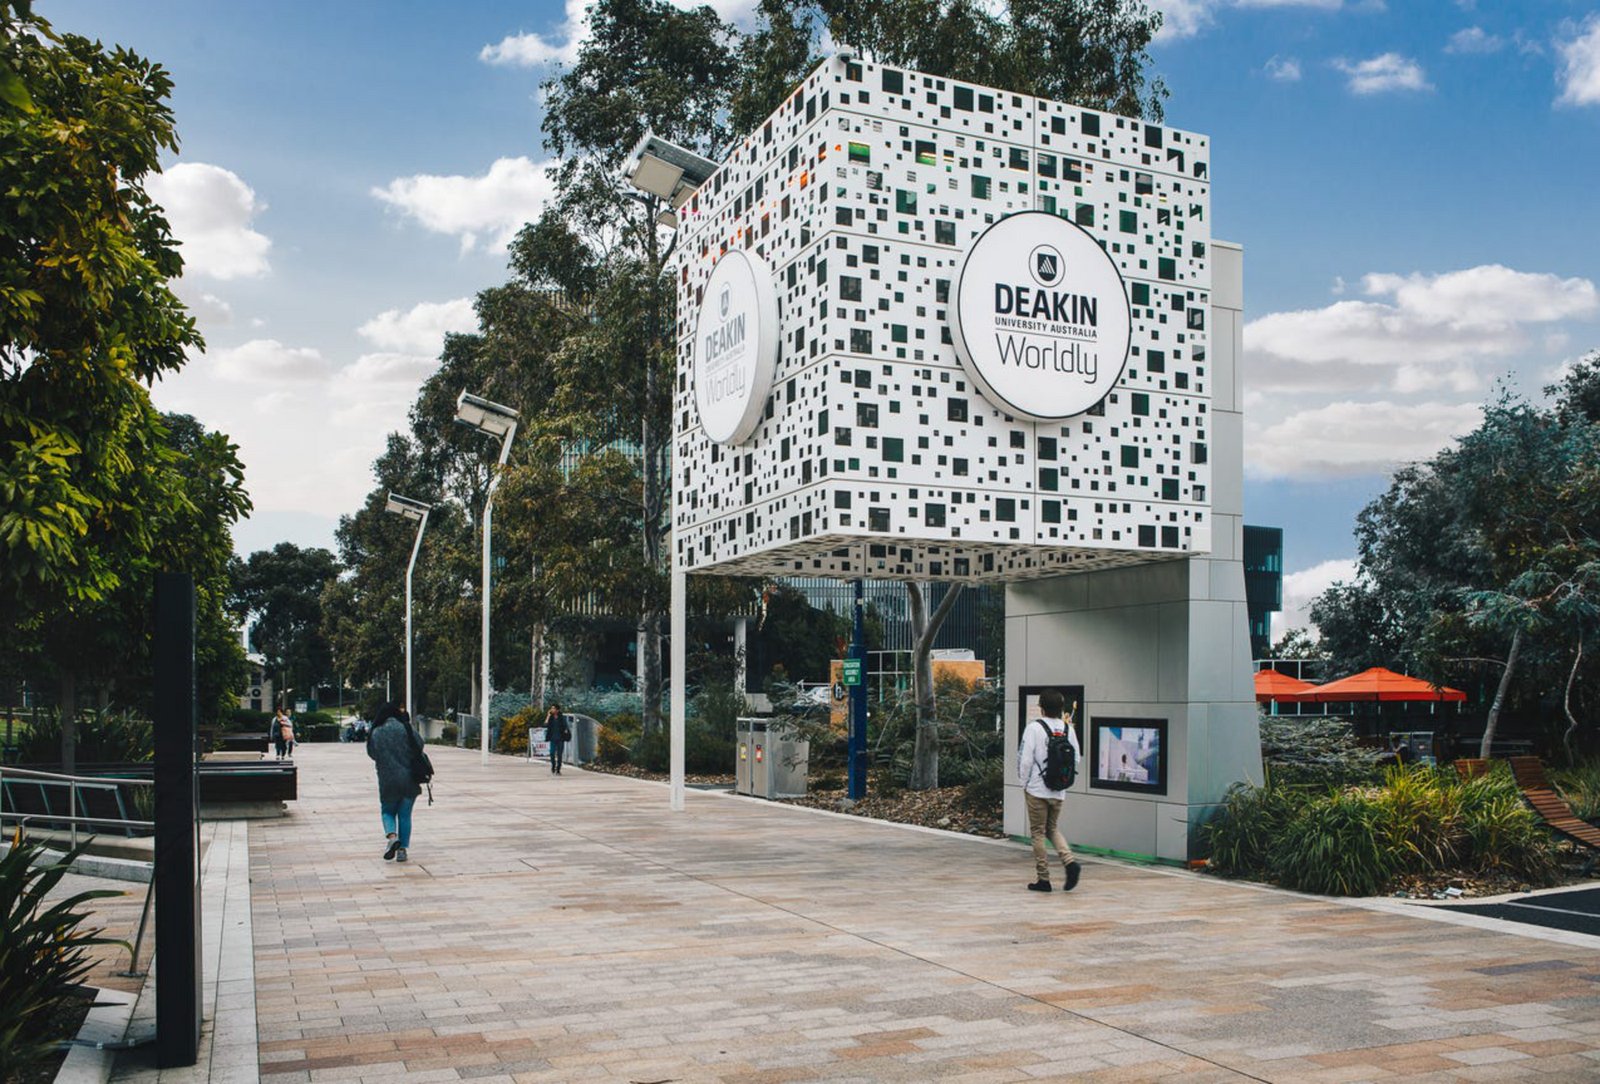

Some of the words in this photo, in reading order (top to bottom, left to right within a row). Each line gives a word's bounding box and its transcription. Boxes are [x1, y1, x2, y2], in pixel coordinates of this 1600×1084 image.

[995, 283, 1097, 327] DEAKIN
[706, 312, 745, 363] DEAKIN
[995, 317, 1047, 331] UNIVERSITY
[1050, 325, 1097, 338] AUSTRALIA
[995, 333, 1097, 384] Worldly
[705, 365, 745, 406] Worldly
